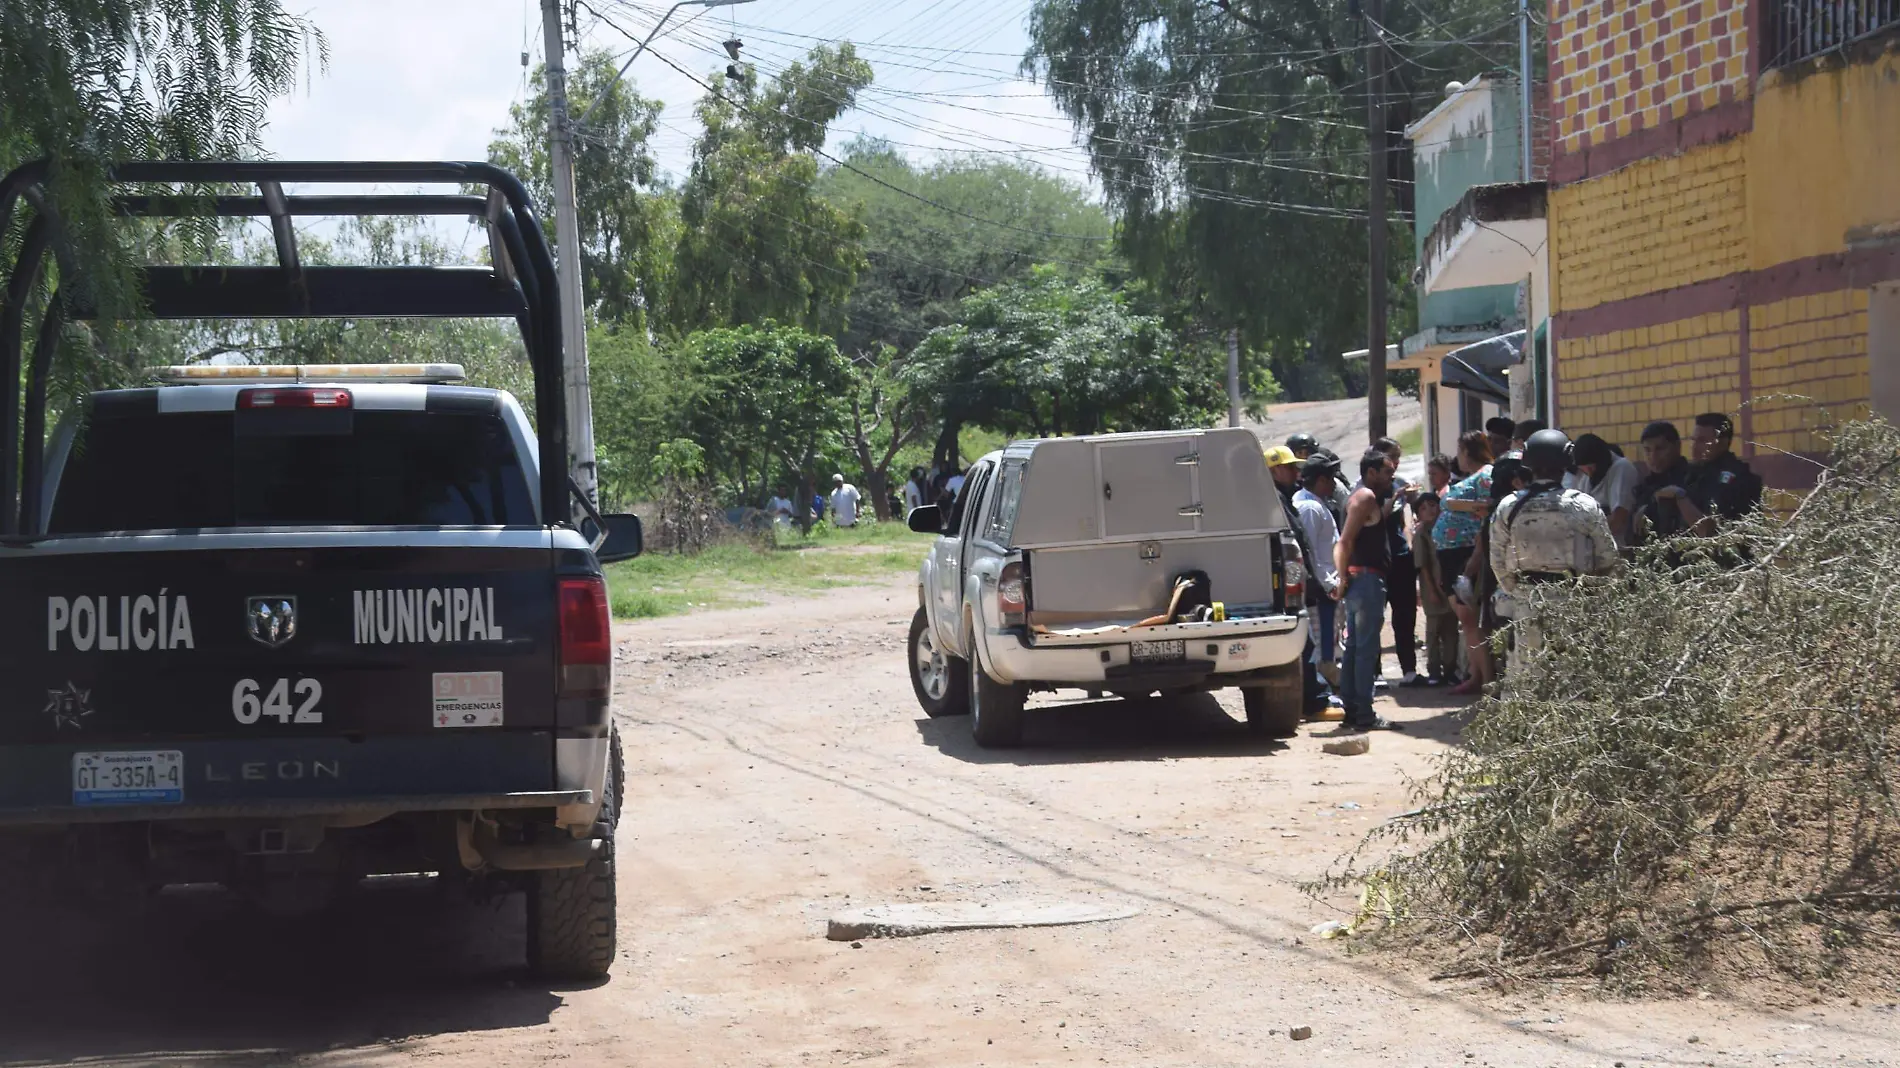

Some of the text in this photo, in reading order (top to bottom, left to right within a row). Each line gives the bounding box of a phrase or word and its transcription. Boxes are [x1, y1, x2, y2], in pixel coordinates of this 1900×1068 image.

[48, 587, 502, 651] POLICÍA MUNICIPAL
[439, 677, 495, 694] 911
[232, 678, 322, 724] 642
[435, 702, 501, 711] EMERGENCIAS
[104, 756, 152, 764] Guanajuato
[77, 766, 178, 789] GT-335A-4
